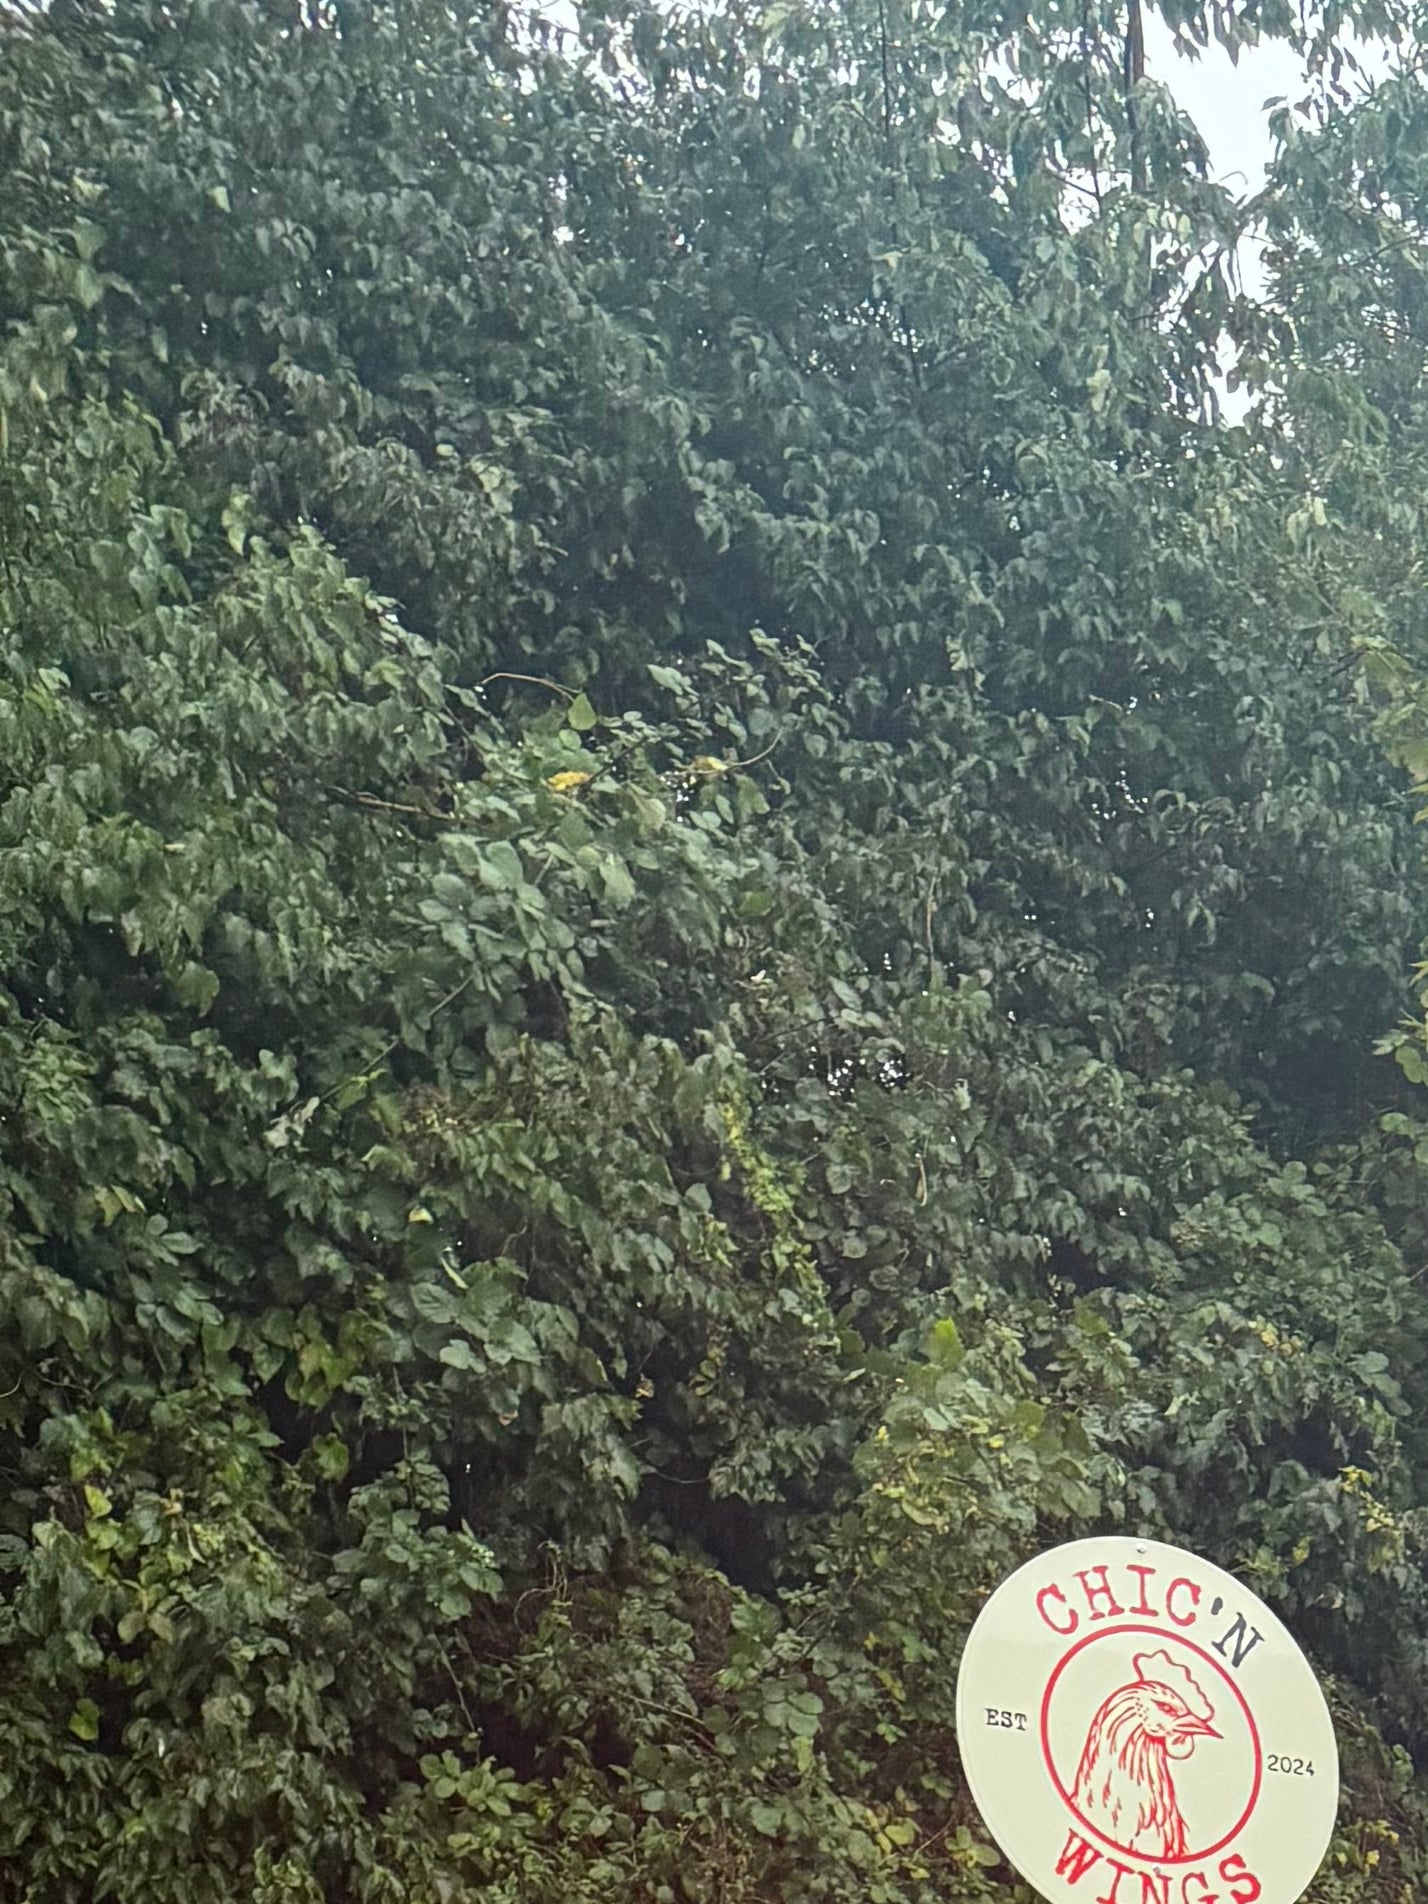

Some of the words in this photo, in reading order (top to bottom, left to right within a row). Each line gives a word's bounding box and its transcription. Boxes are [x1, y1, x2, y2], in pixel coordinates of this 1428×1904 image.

[1036, 1564, 1264, 1669] CHIC'N
[984, 1708, 1027, 1731] EST
[1268, 1755, 1315, 1777] 2024
